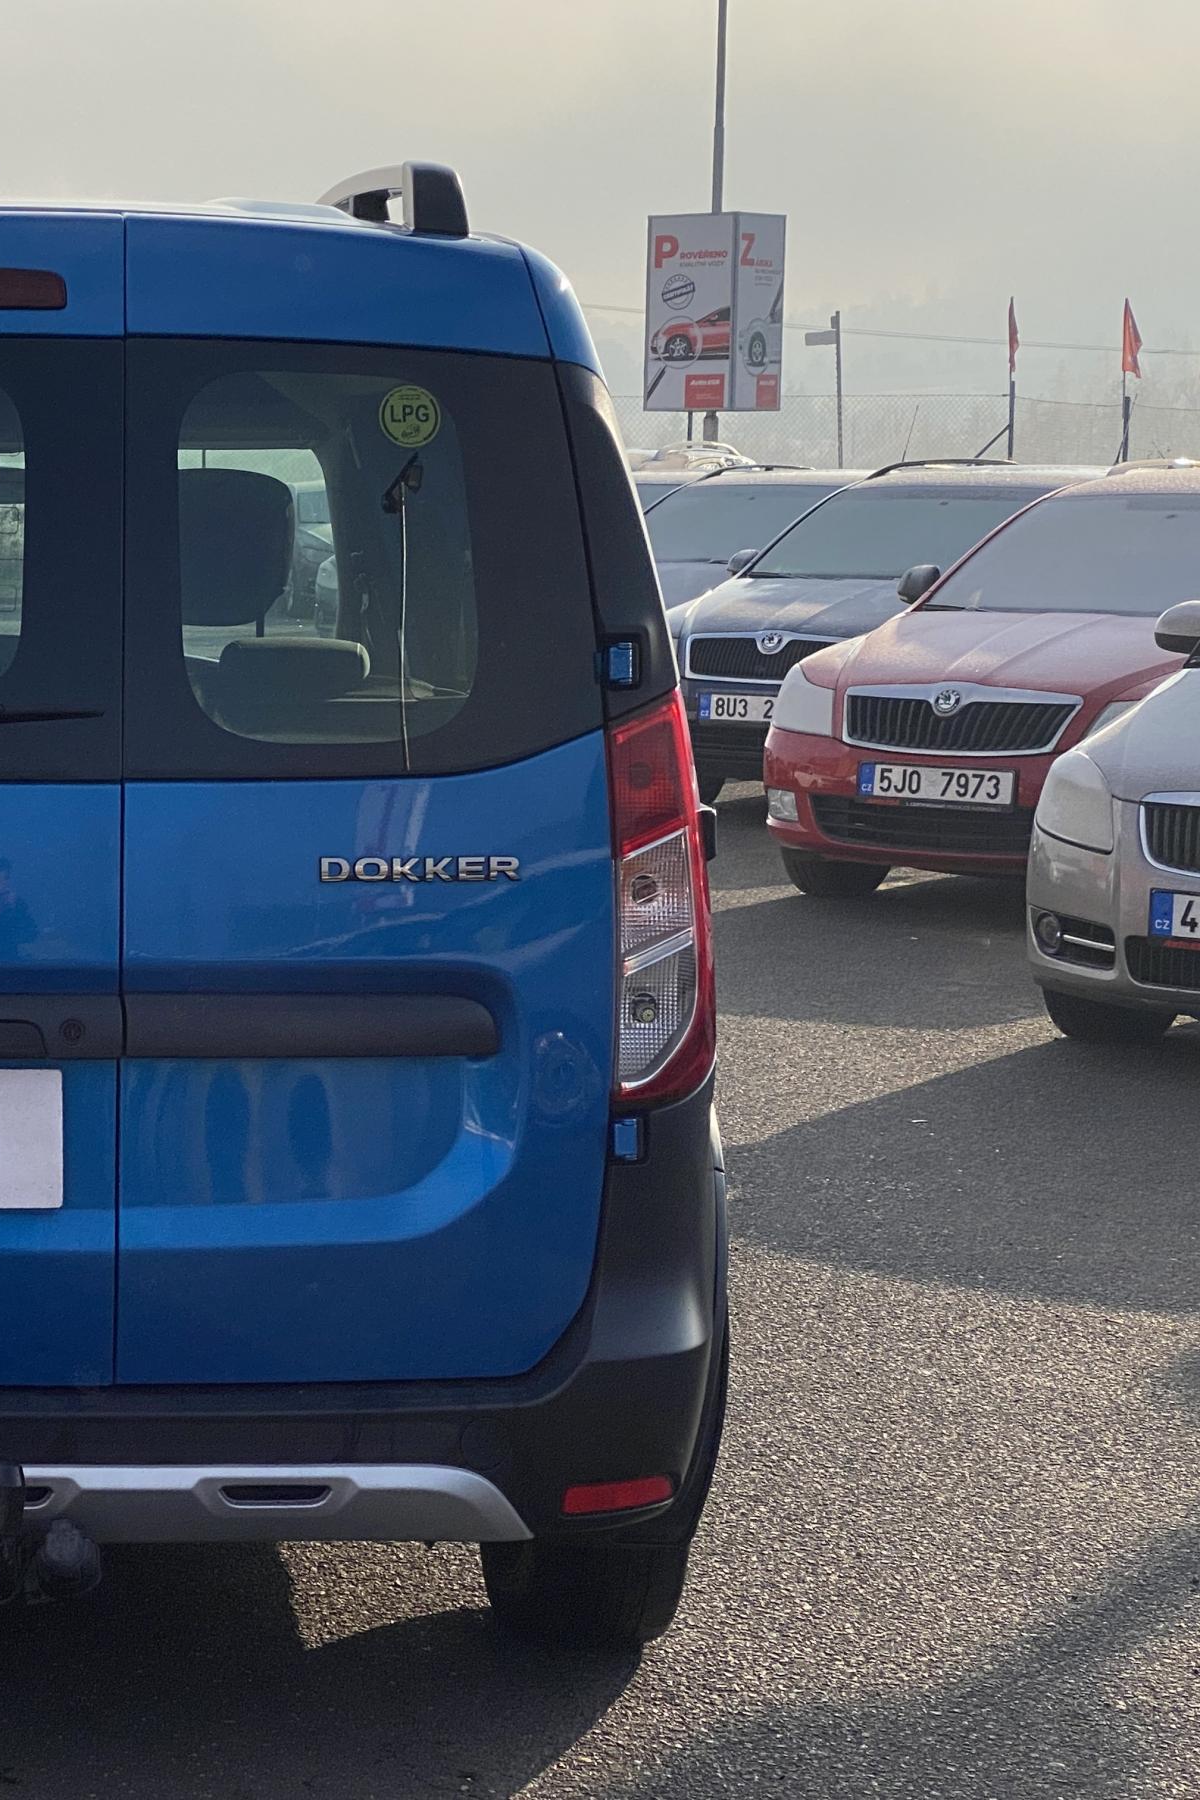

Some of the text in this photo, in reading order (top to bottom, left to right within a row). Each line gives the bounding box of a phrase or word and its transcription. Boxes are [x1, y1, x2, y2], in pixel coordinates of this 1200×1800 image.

[390, 404, 430, 423] LPG
[715, 697, 748, 718] 8U3
[861, 783, 872, 792] CZ
[879, 768, 1000, 800] 5J0 7973
[319, 856, 521, 882] DOKKER
[1154, 919, 1170, 930] CZ
